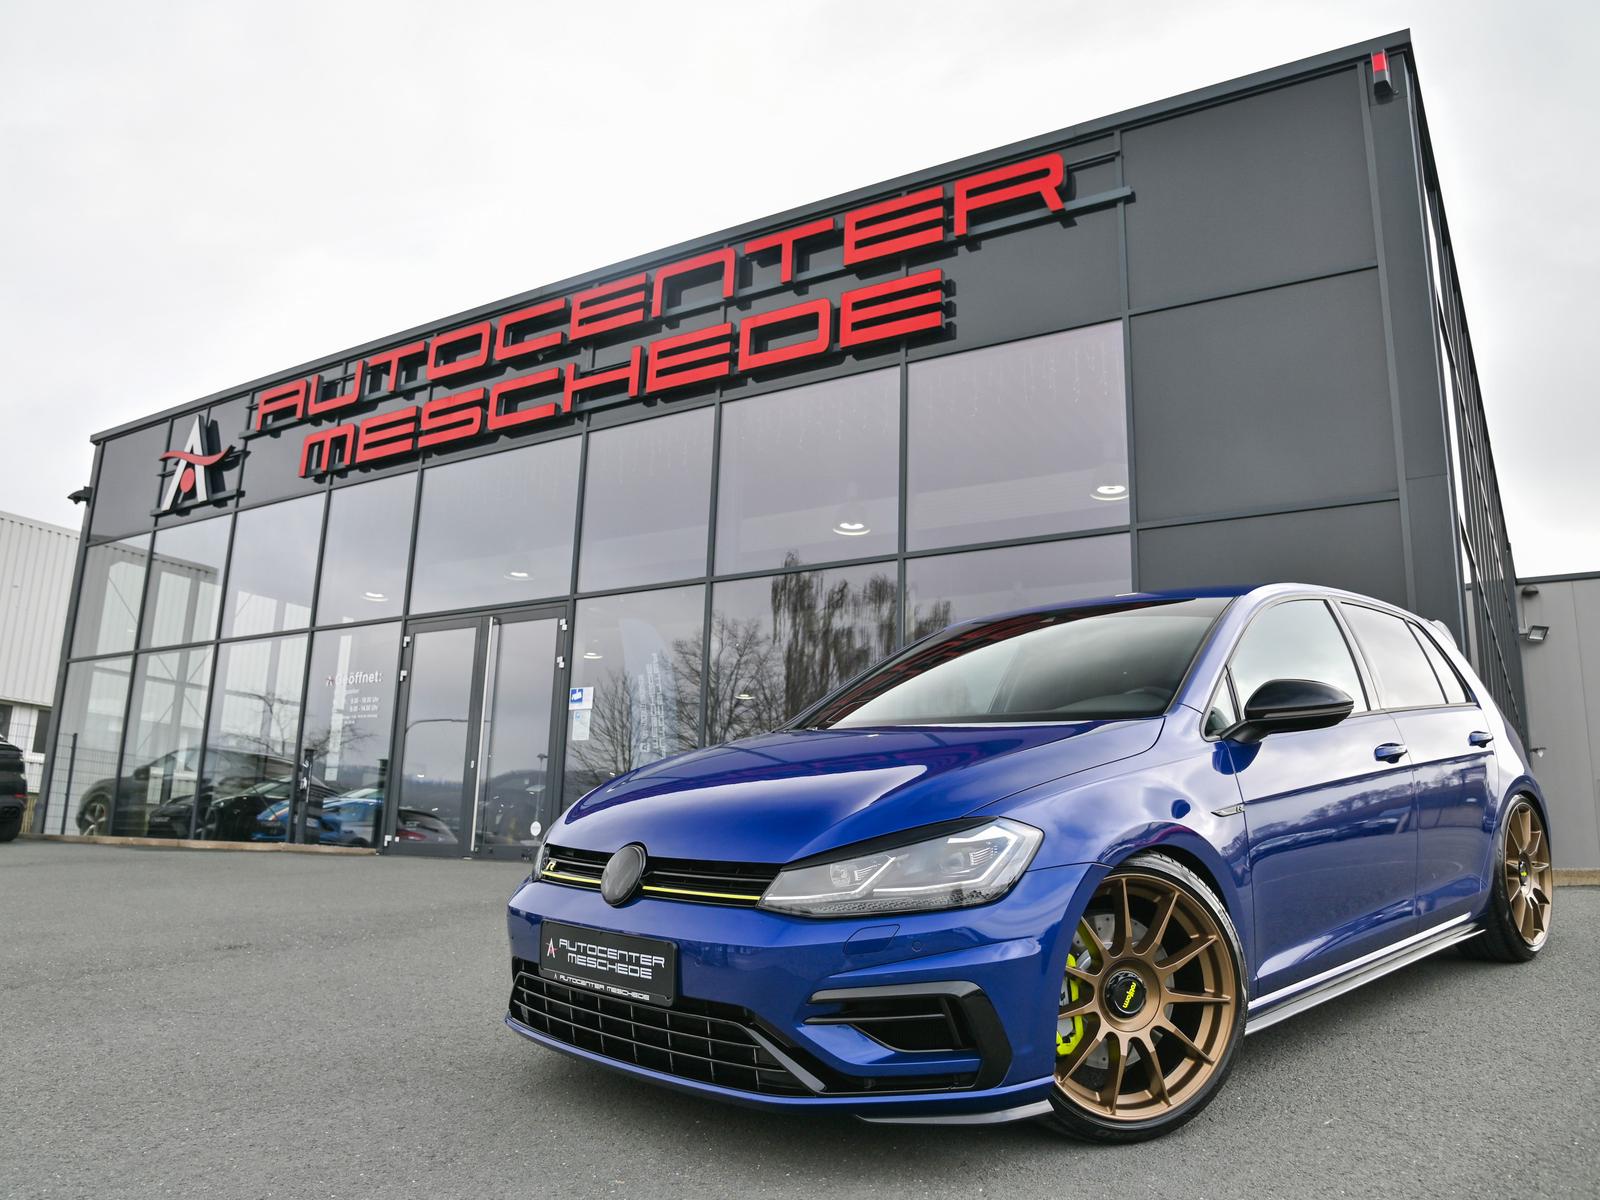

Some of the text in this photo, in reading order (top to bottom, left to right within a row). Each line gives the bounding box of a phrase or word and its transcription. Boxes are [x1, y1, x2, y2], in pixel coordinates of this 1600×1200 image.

[255, 153, 1064, 432] AUTOCENTER
[299, 268, 944, 478] MESCHEDE
[559, 938, 665, 968] AUTOCENTER
[567, 952, 653, 980] MESCHEDE
[559, 975, 605, 991] AUTOCENTER
[606, 986, 650, 1001] MESCHEDE
